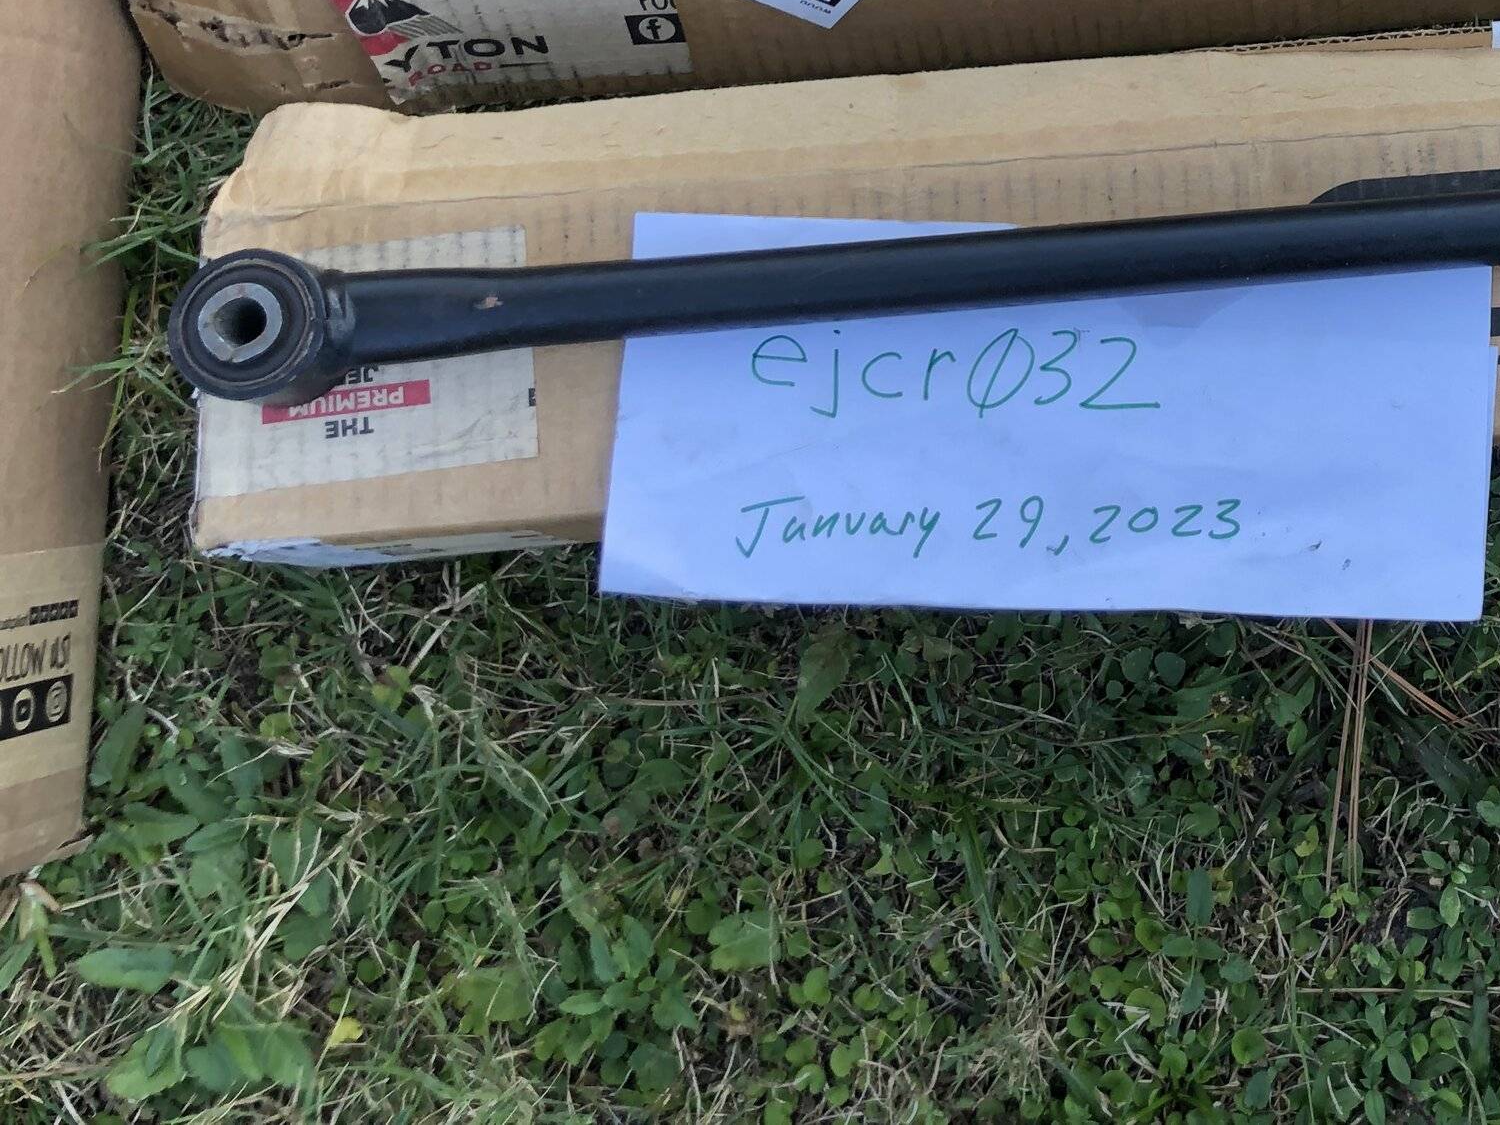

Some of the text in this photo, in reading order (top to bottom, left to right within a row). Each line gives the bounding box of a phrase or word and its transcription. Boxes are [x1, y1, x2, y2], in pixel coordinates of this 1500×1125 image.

[288, 385, 405, 417] PREMIUM
[324, 416, 375, 439] THE
[735, 495, 941, 559] January
[1088, 497, 1242, 546] 2023
